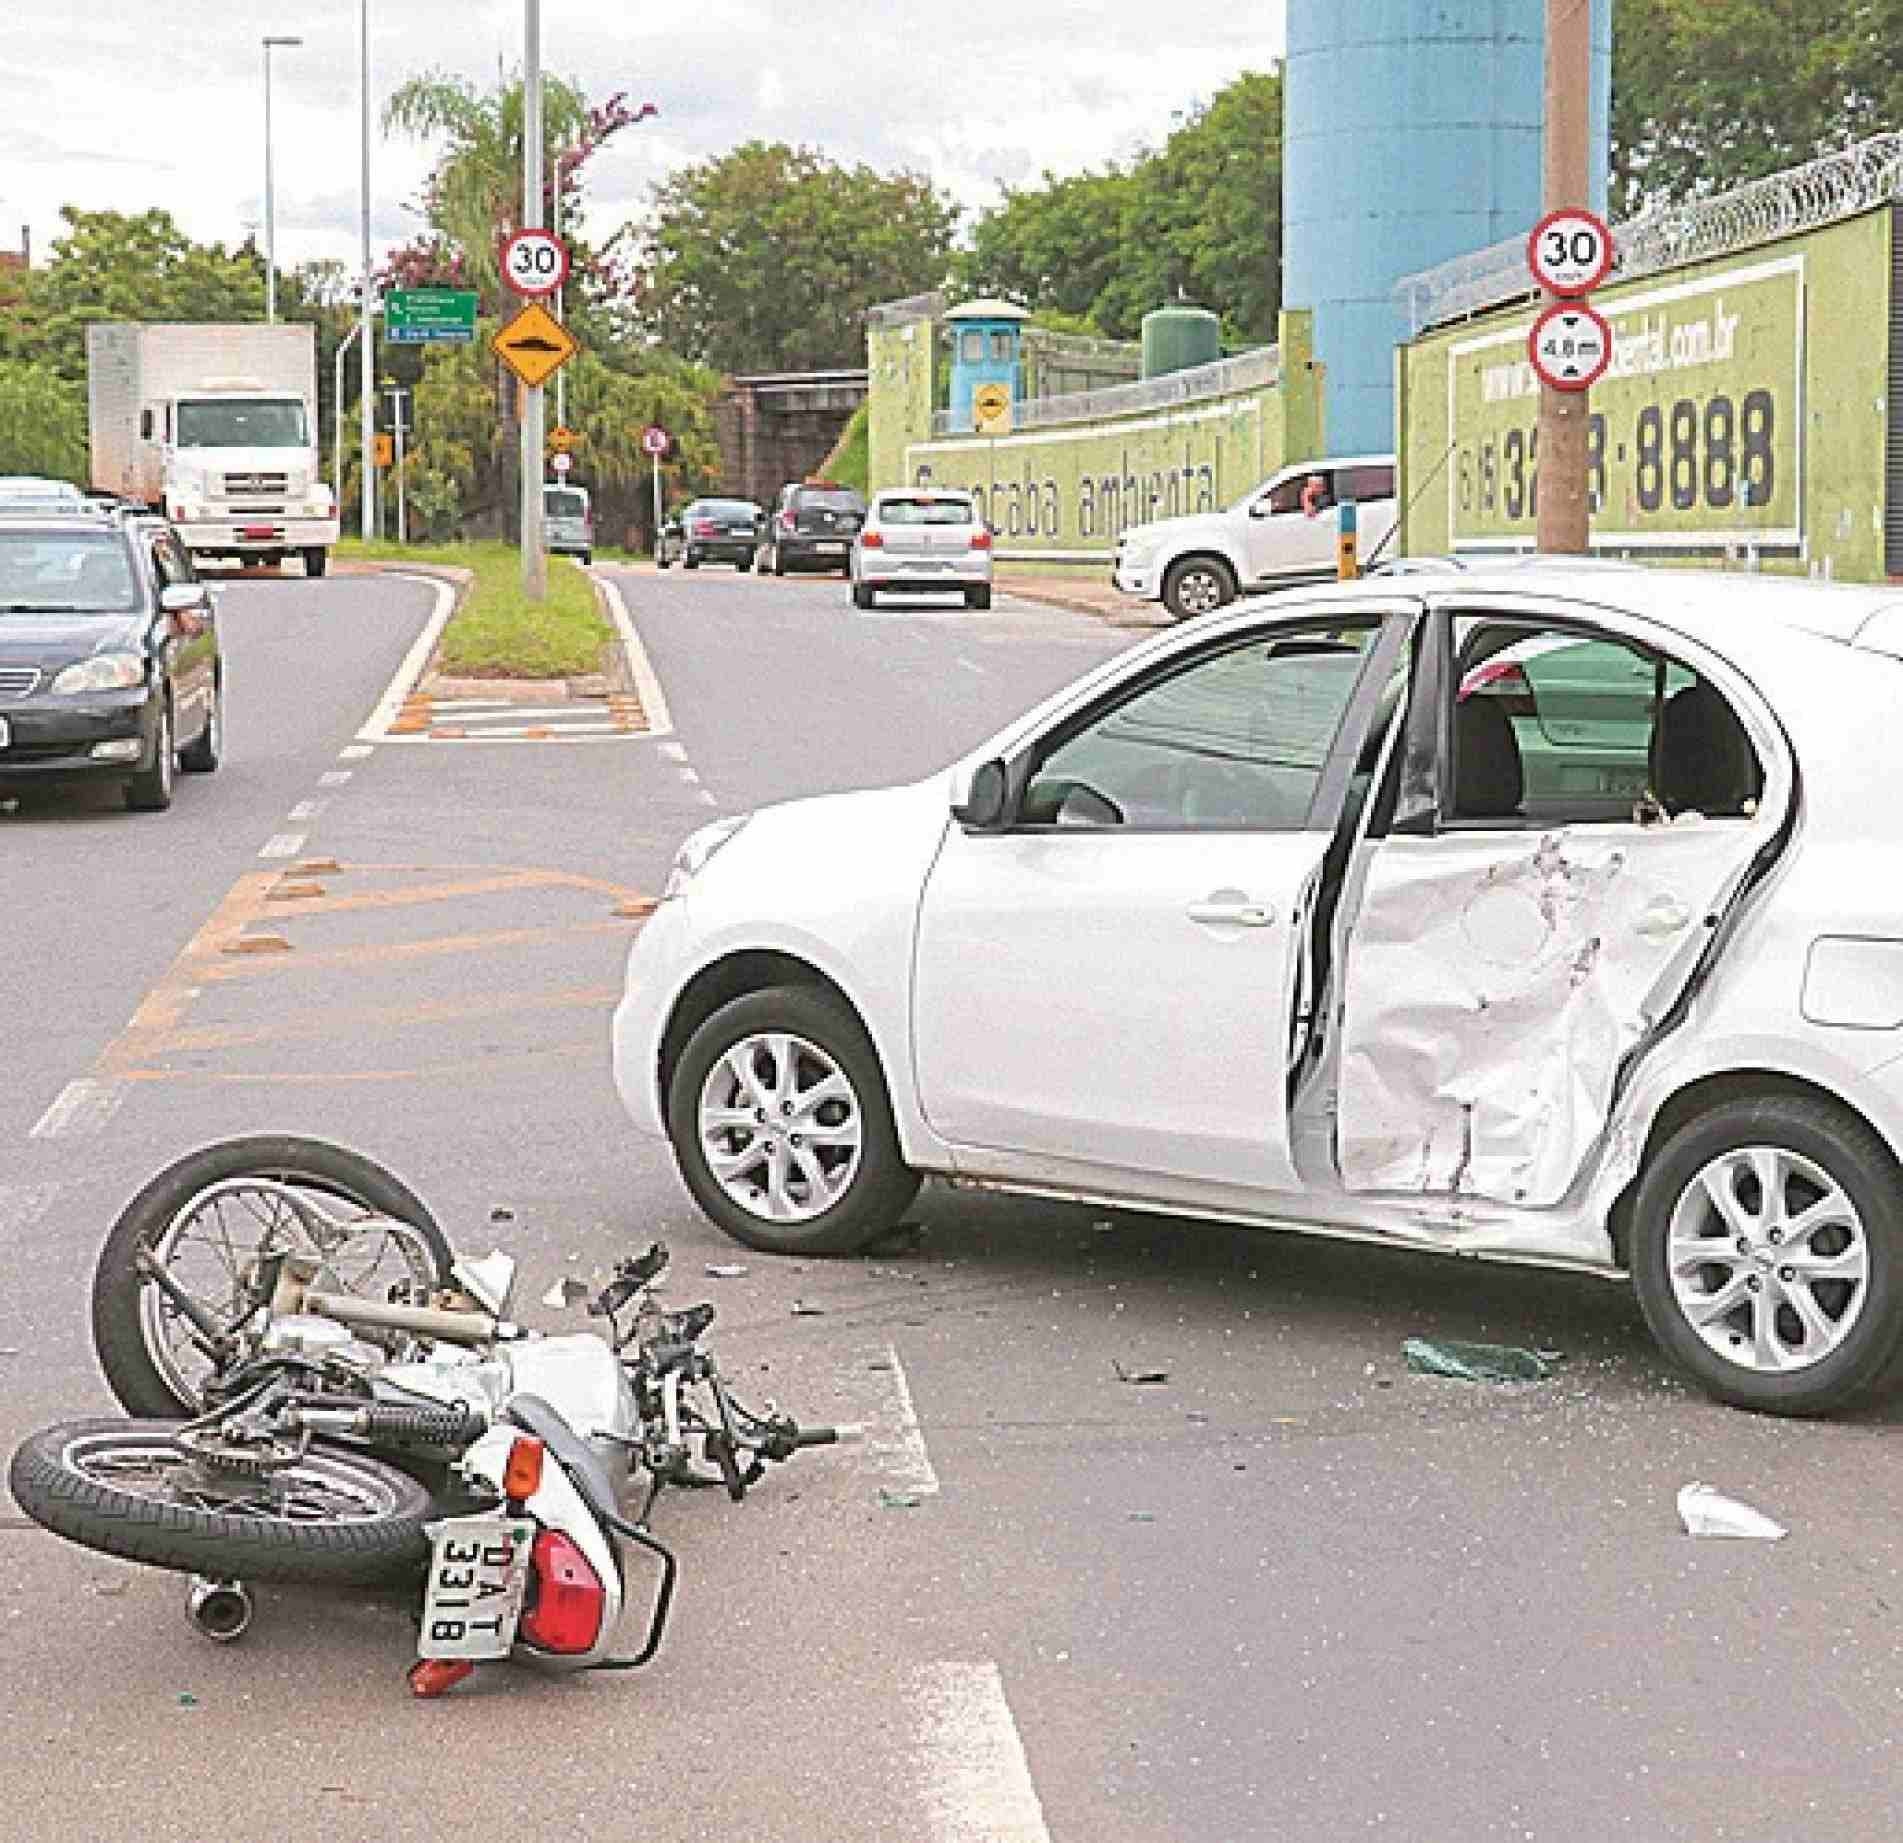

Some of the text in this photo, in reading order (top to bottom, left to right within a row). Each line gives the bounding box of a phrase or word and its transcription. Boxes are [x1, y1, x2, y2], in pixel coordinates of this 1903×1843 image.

[513, 243, 555, 274] 30
[1545, 231, 1597, 267] 30
[470, 1547, 514, 1636] DAT
